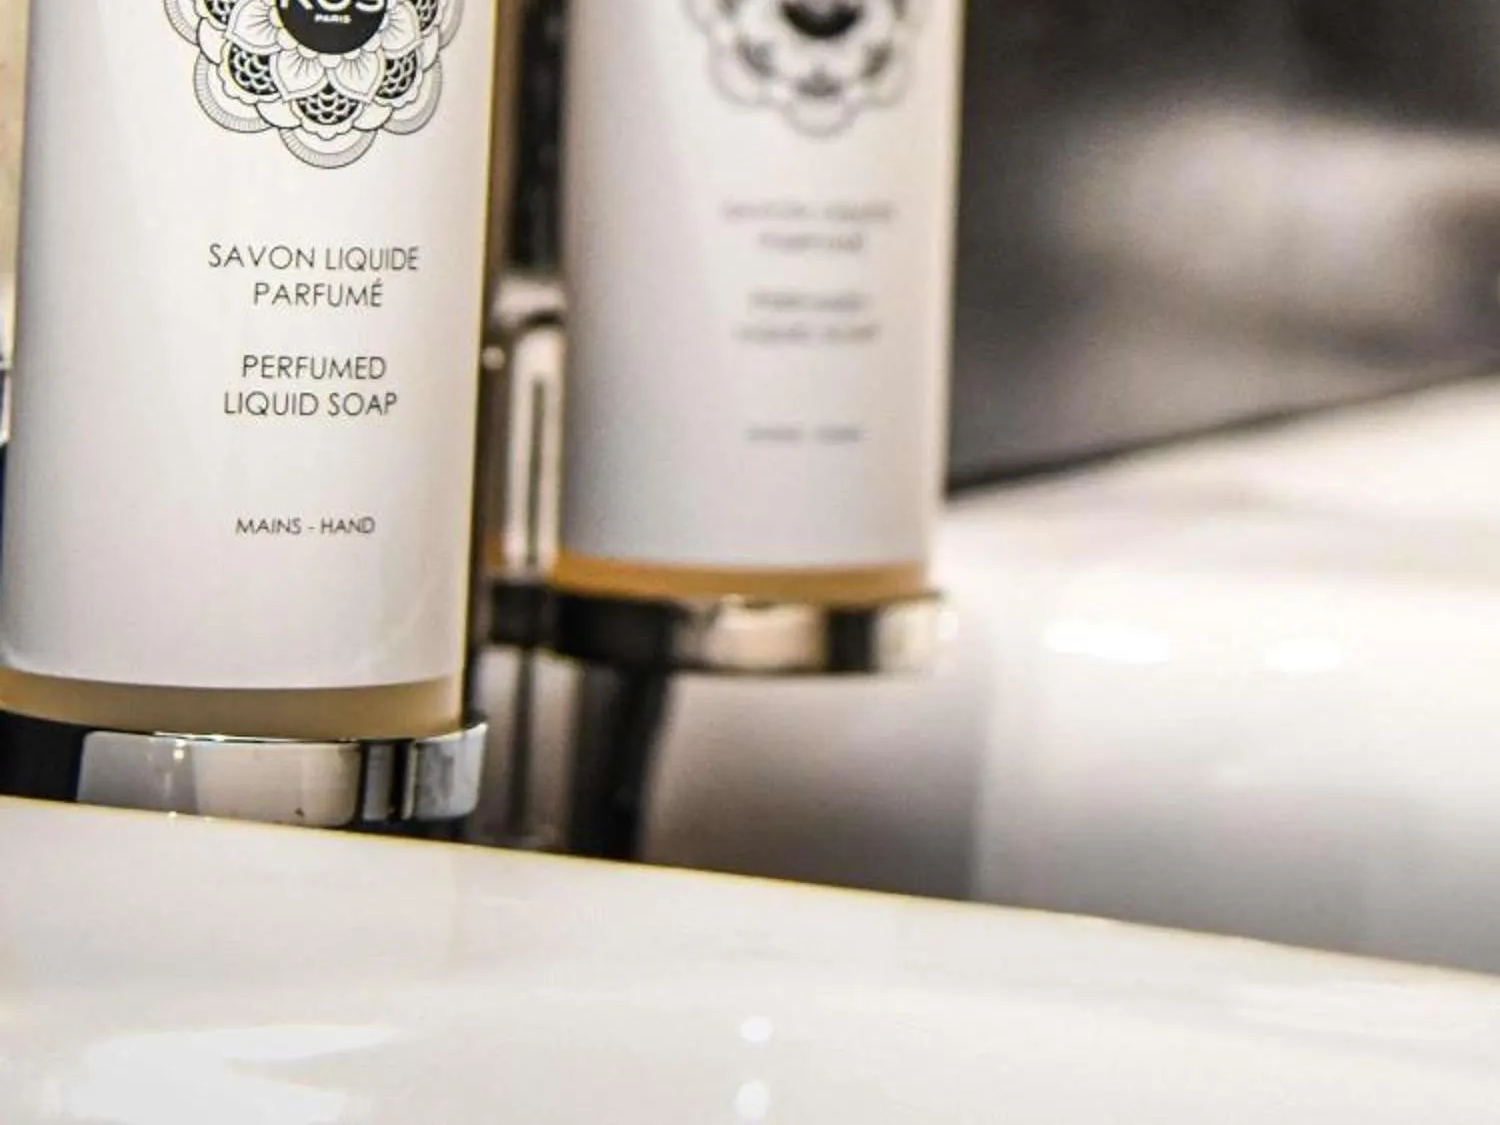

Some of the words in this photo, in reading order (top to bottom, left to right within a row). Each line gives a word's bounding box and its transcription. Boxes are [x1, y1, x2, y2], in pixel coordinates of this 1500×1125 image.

[208, 242, 315, 271] SAVON
[323, 245, 420, 272] LIQUIDE
[252, 278, 384, 308] PARFUMÉ
[241, 354, 388, 381] PERFUMED
[222, 390, 320, 417] LIQUID
[326, 391, 398, 417] SOAP
[234, 517, 303, 535] MAINS
[319, 516, 376, 535] HAND
